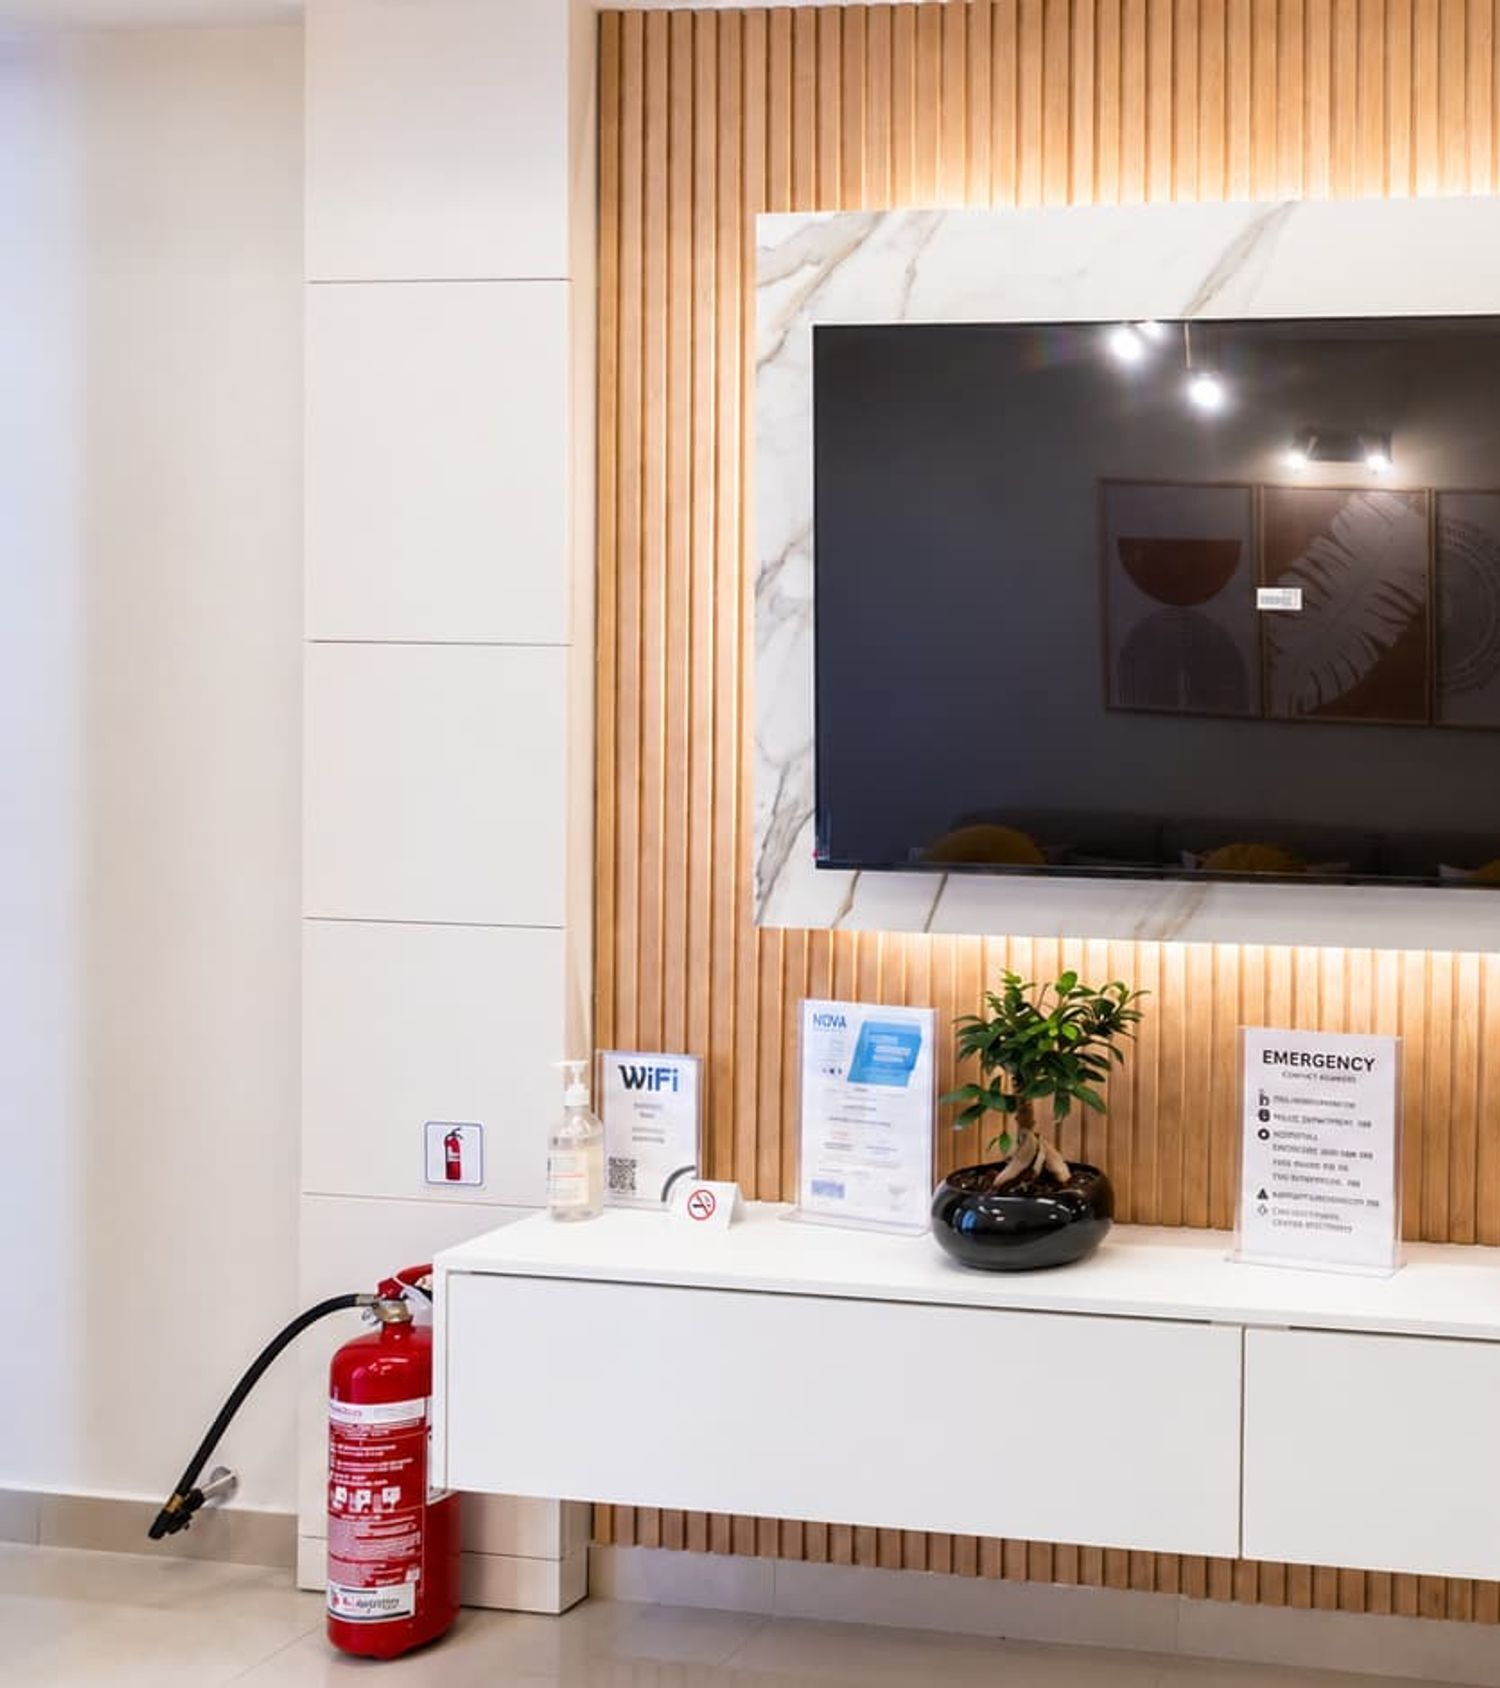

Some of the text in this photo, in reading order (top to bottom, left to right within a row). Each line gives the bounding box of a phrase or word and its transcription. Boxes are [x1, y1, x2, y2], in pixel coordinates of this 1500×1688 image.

[813, 1013, 847, 1030] NOVA
[1262, 1049, 1376, 1073] EMERGENCY
[617, 1064, 679, 1092] WiFi
[1281, 1070, 1318, 1081] COACT
